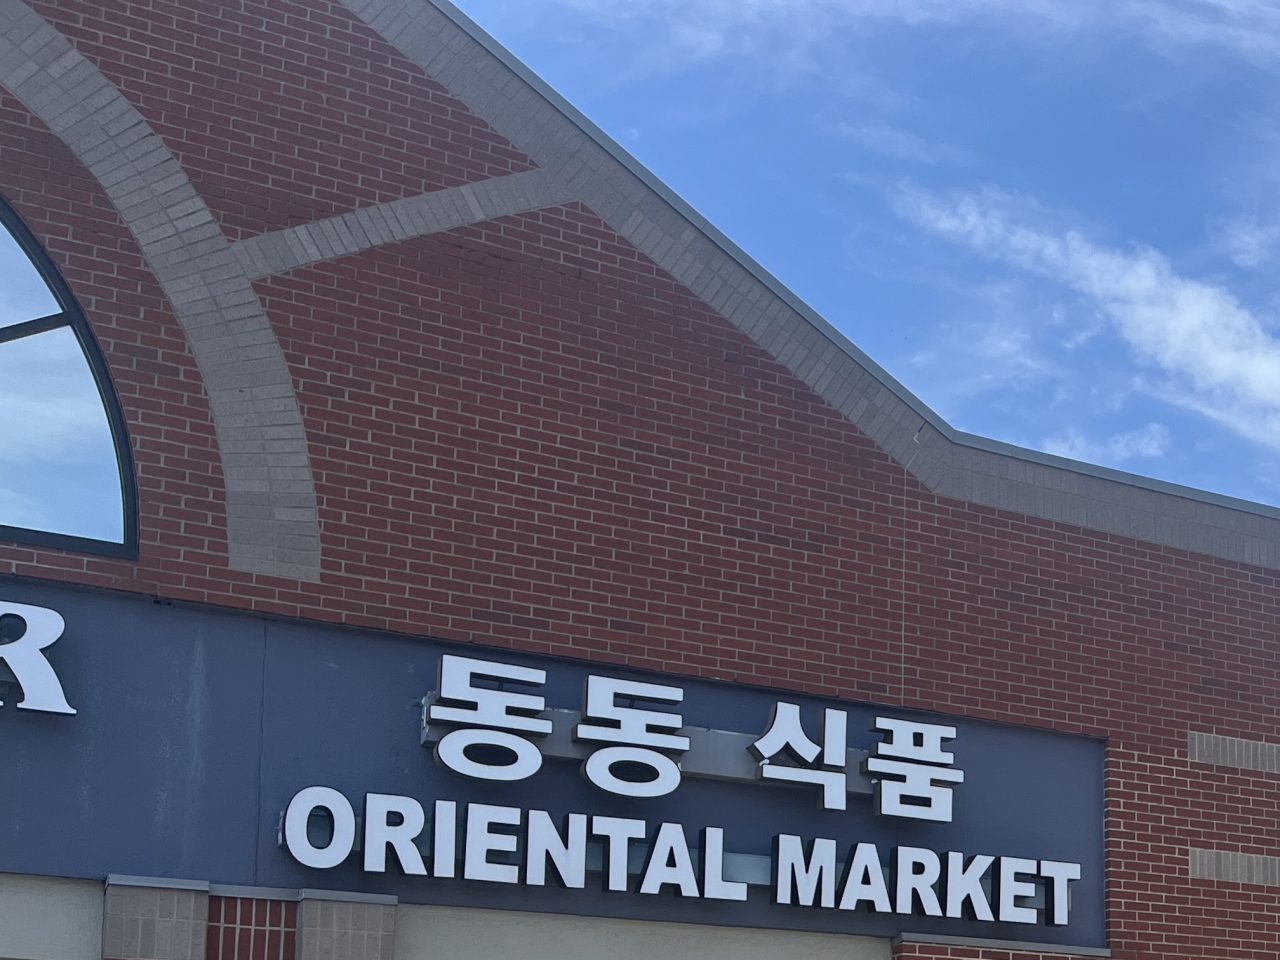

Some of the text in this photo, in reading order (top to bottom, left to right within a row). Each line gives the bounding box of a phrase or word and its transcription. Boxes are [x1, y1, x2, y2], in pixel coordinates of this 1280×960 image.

[429, 653, 965, 823] 동동 식품
[284, 786, 1082, 926] ORIENTAL MARKET
